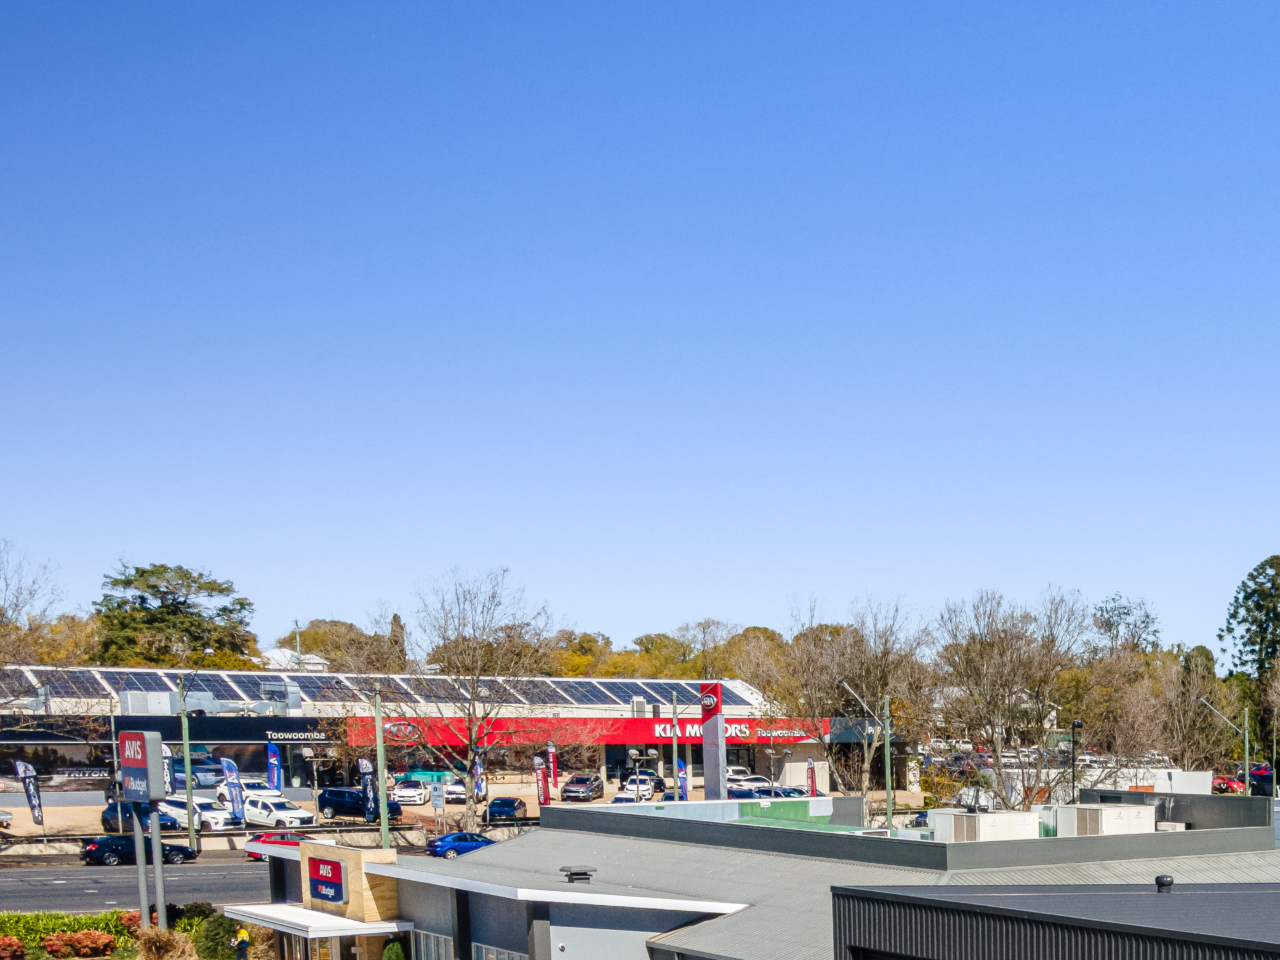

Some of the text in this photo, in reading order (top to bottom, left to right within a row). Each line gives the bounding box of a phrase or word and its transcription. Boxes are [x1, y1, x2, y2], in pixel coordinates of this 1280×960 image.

[265, 731, 327, 740] Toowoomba
[654, 724, 683, 738] KIA
[124, 740, 142, 760] AVIS
[130, 777, 148, 796] Budget
[319, 864, 333, 878] AVIS
[322, 885, 335, 899] Budget
